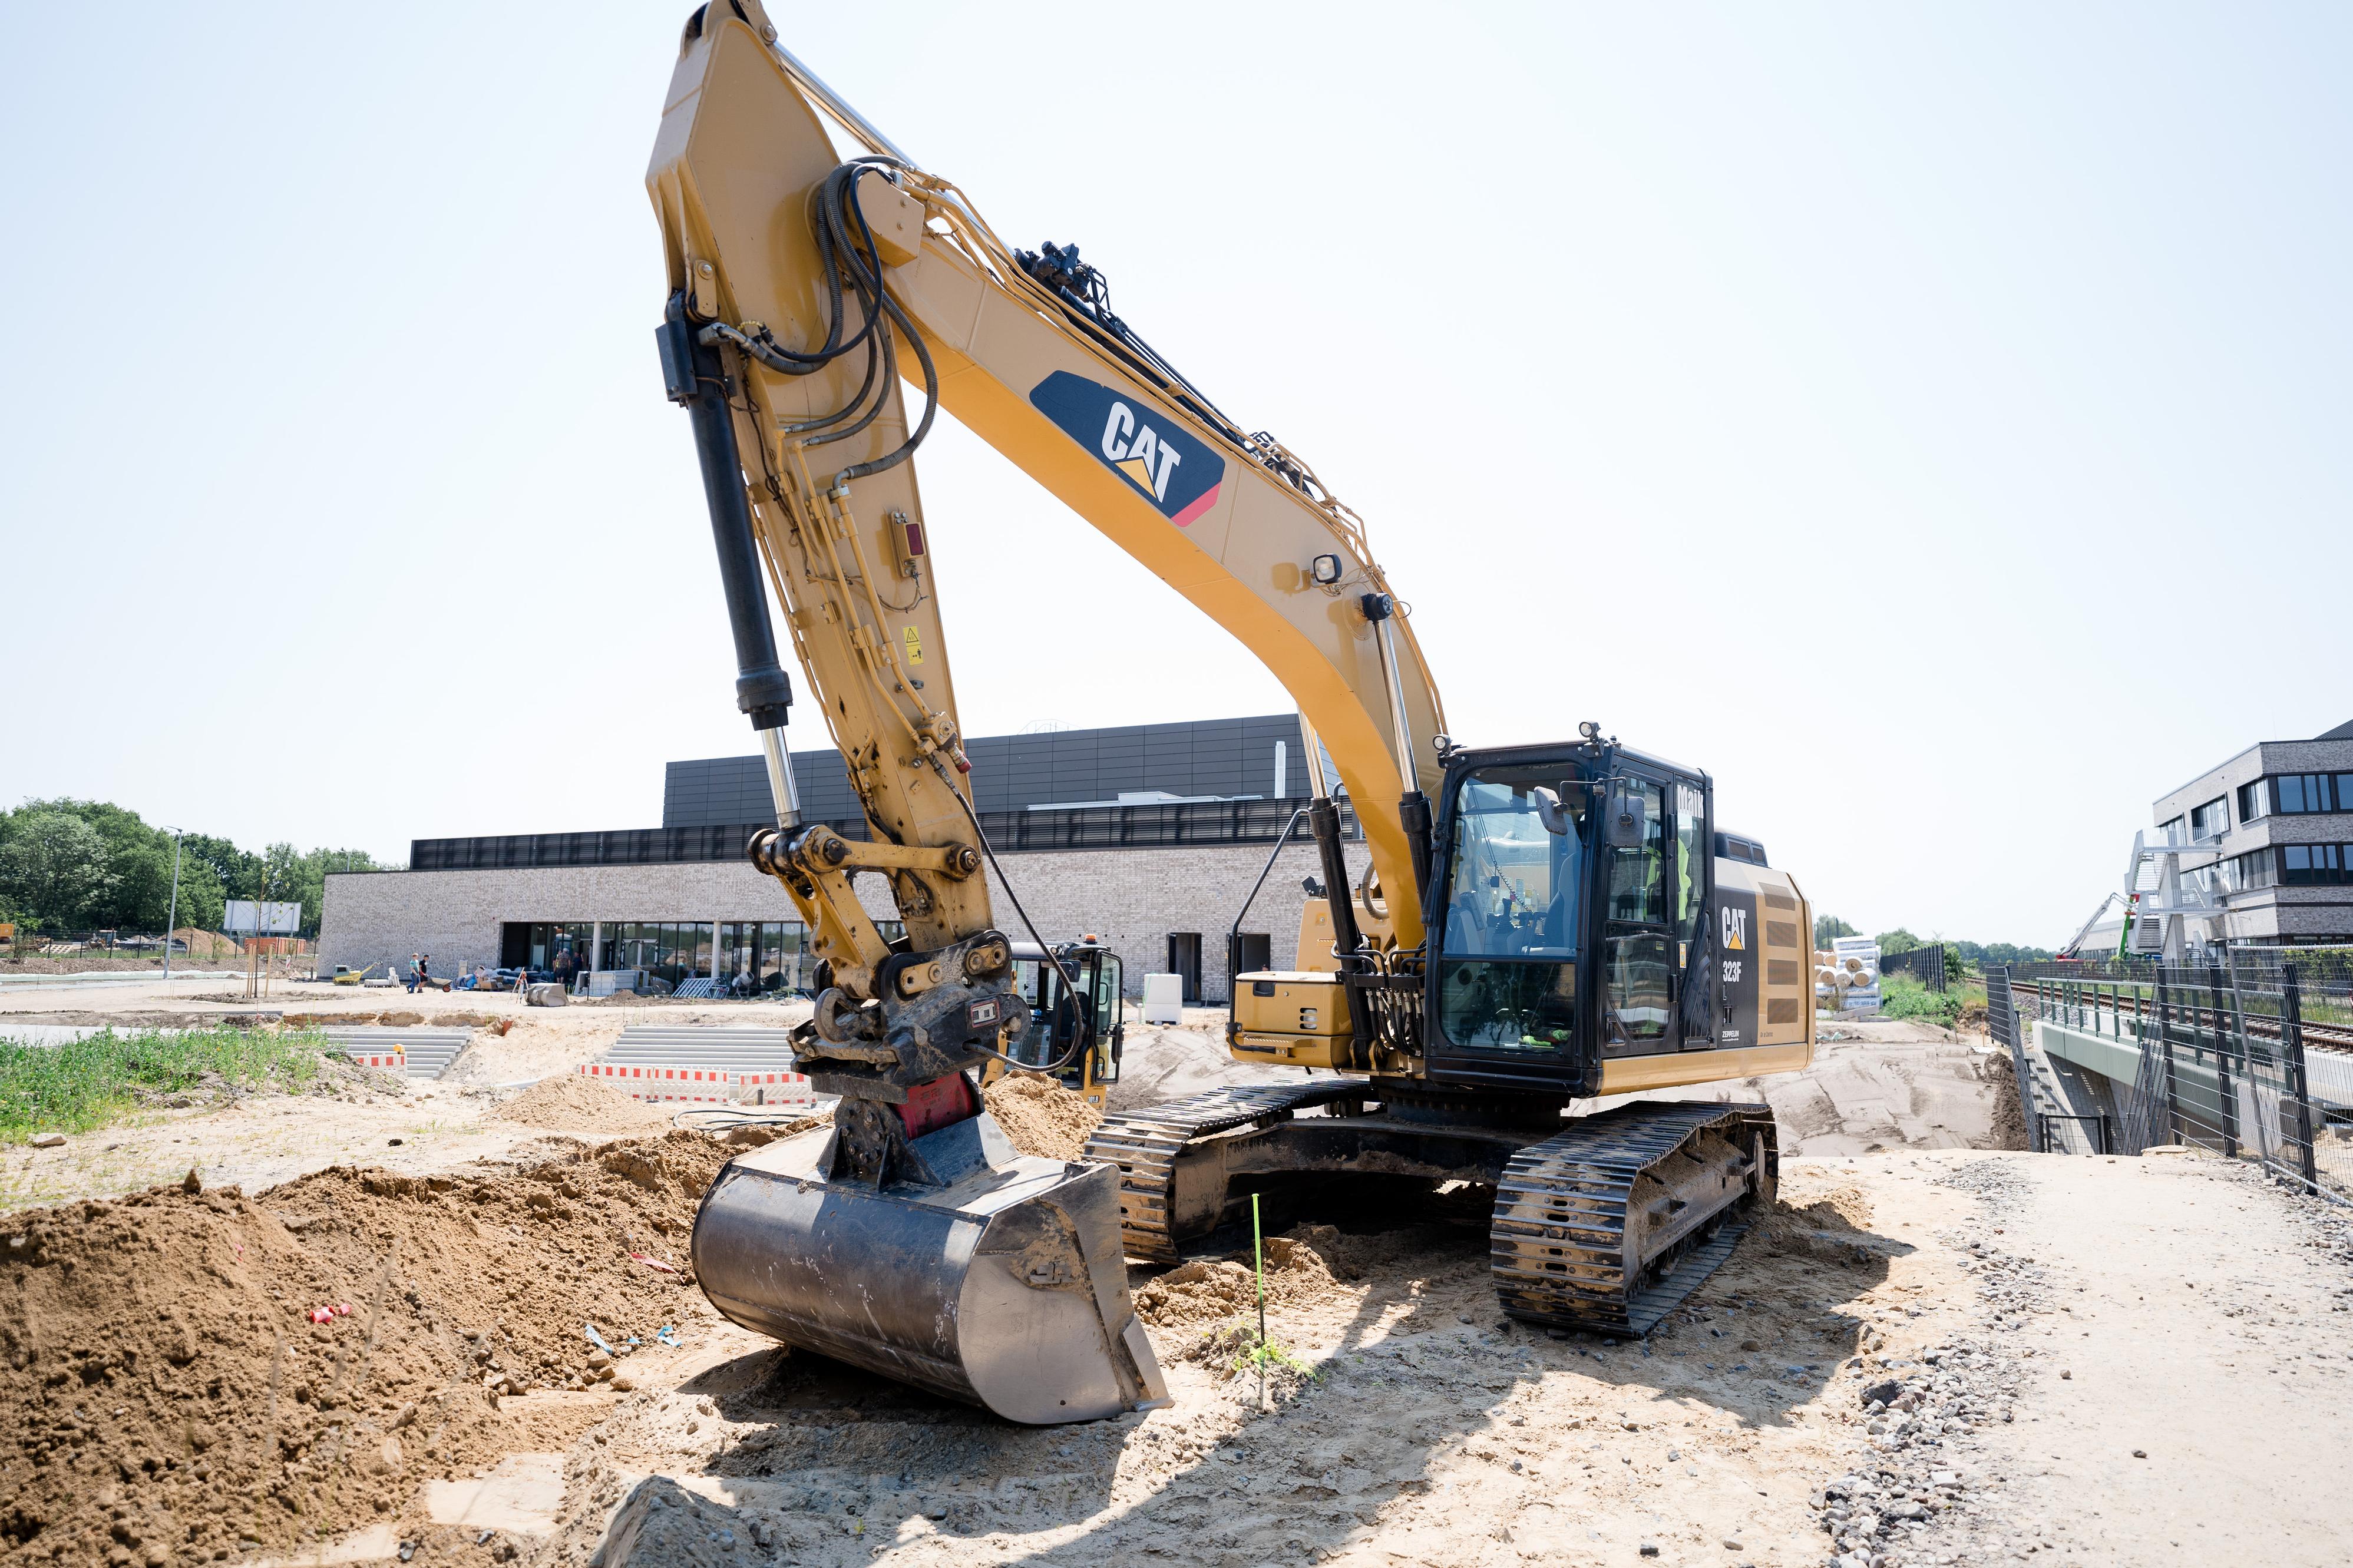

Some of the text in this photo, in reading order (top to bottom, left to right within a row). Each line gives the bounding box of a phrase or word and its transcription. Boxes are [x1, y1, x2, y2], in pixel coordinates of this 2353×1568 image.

[1102, 402, 1181, 503] CAT
[1677, 785, 1703, 819] Maik
[1721, 907, 1746, 950] CAT
[1723, 961, 1741, 983] 323F
